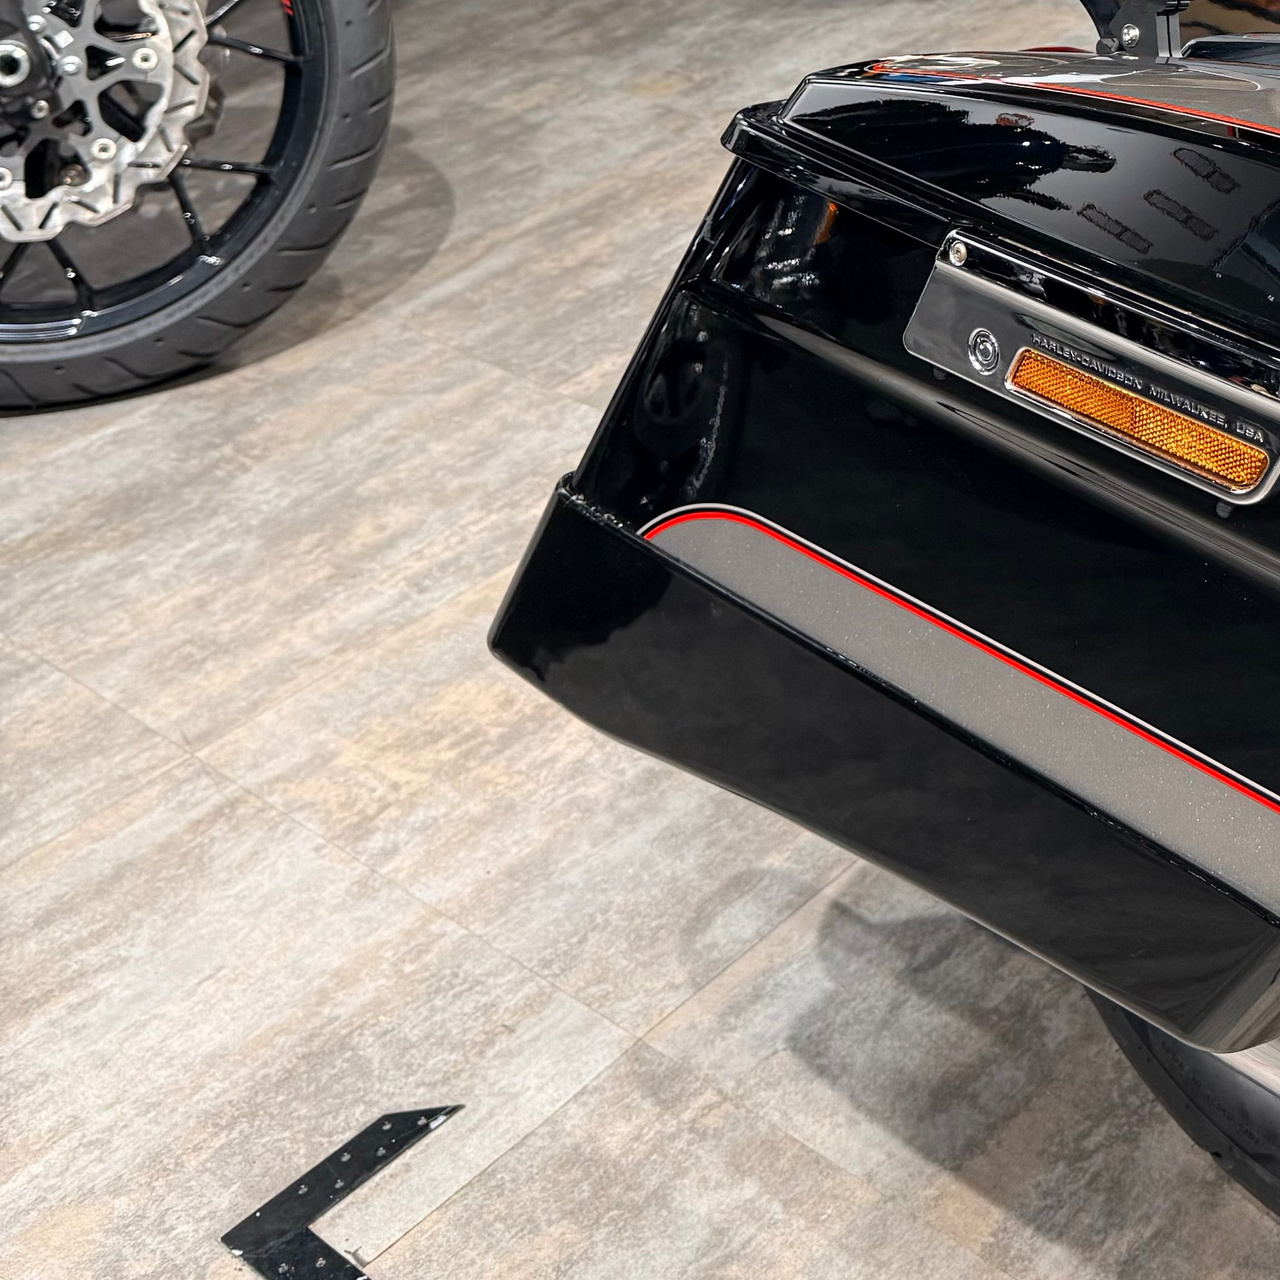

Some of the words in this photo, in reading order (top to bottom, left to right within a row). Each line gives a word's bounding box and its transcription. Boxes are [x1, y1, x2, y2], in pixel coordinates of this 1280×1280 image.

[1031, 333, 1143, 390] HARLEY-DAVIDSON
[1149, 384, 1229, 428] MILWAUKEE,
[1234, 421, 1265, 443] USA
